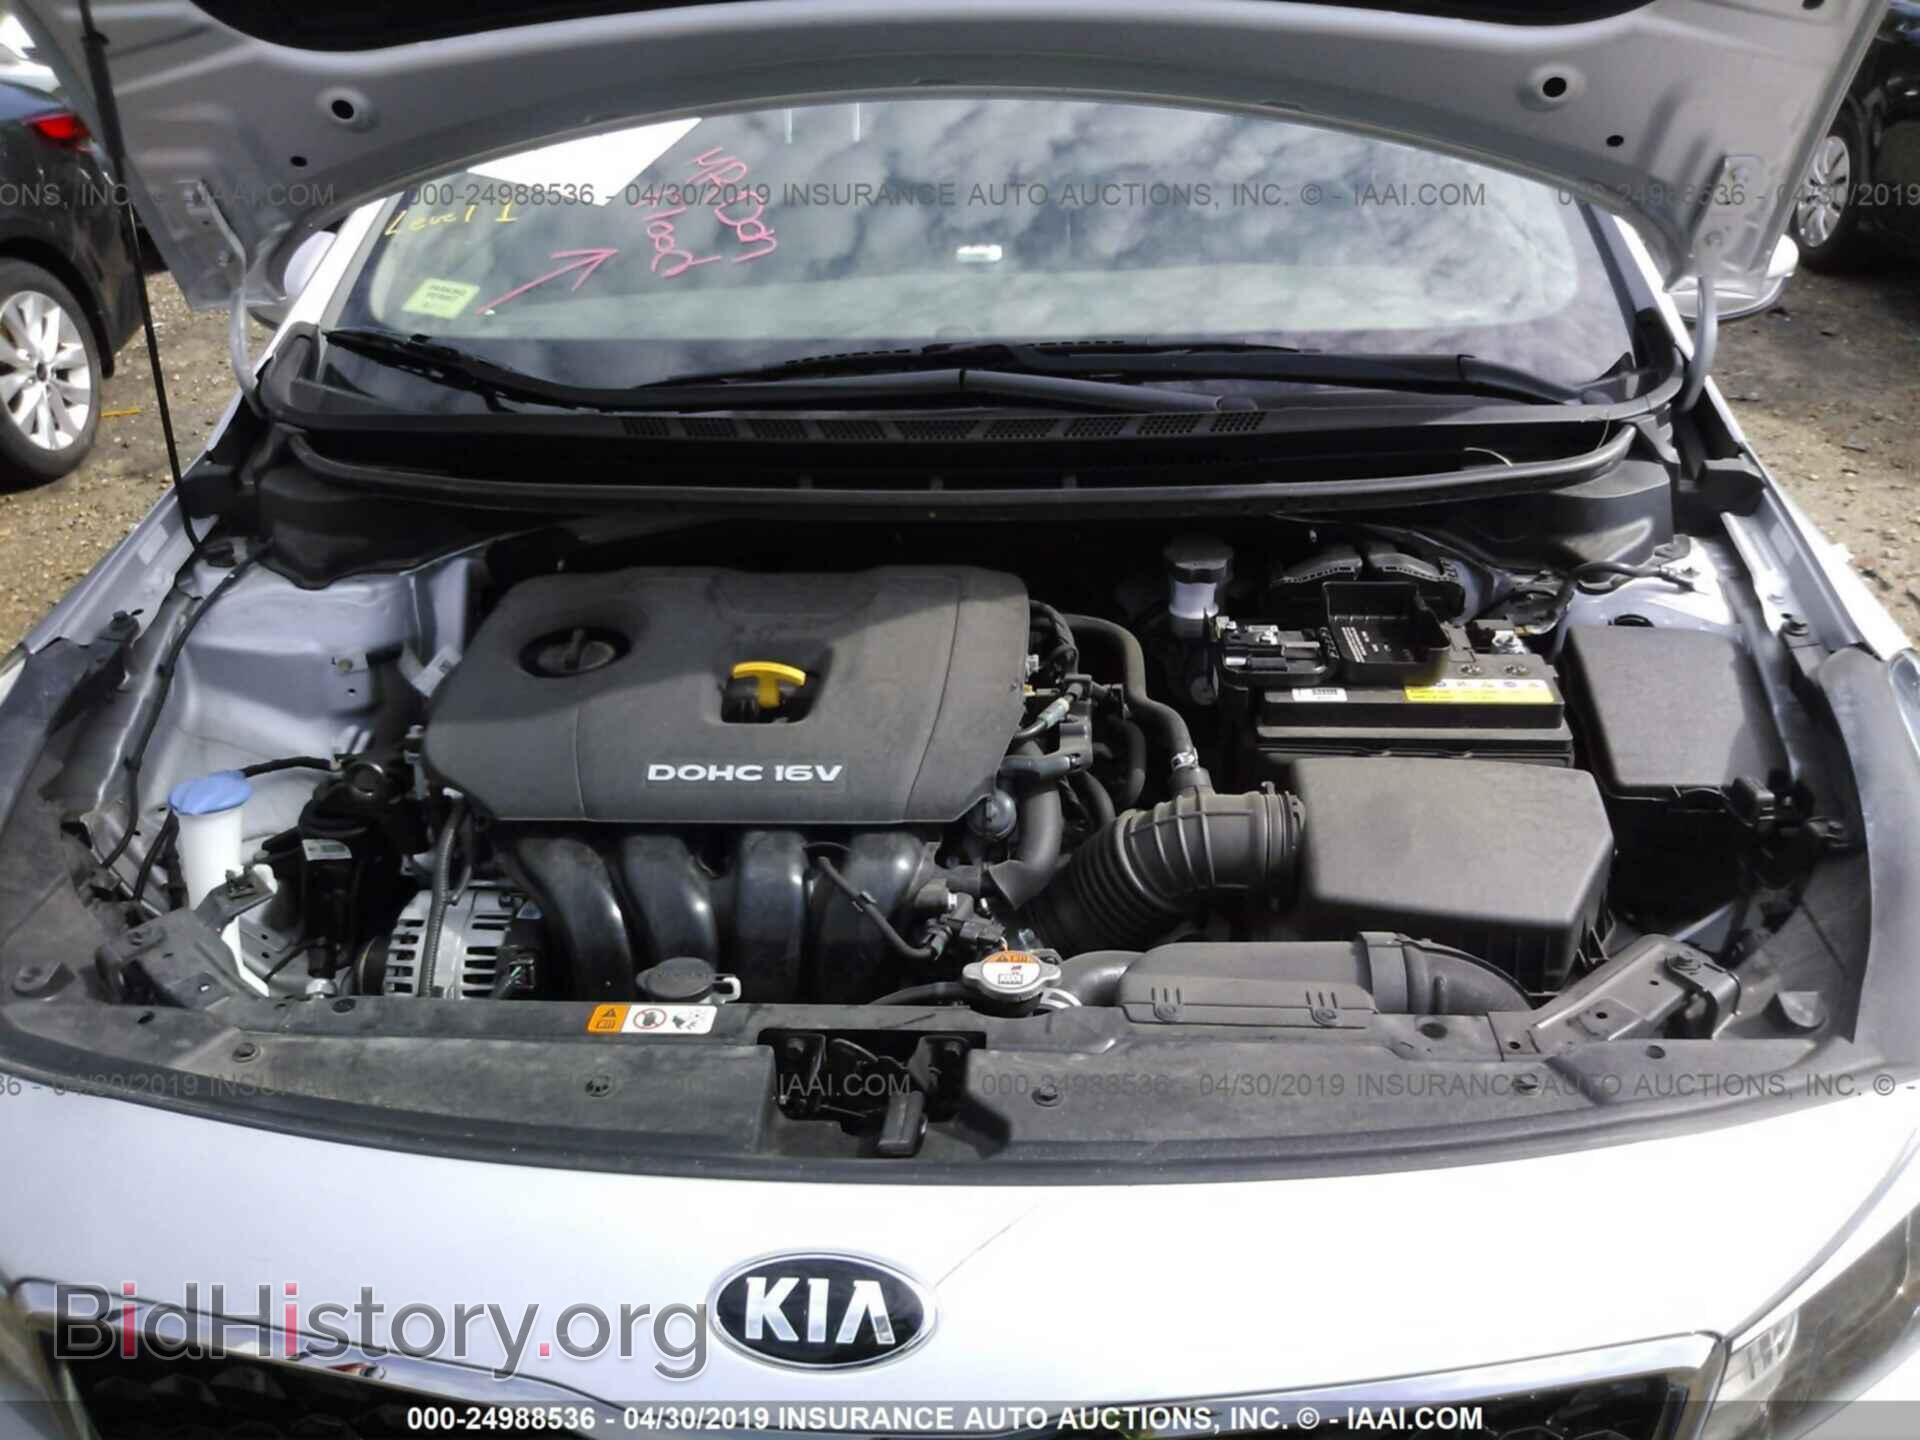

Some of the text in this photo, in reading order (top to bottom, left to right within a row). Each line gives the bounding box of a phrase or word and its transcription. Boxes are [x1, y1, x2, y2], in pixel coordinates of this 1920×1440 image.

[647, 763, 844, 782] DOHC 16V
[744, 1275, 897, 1346] KIA
